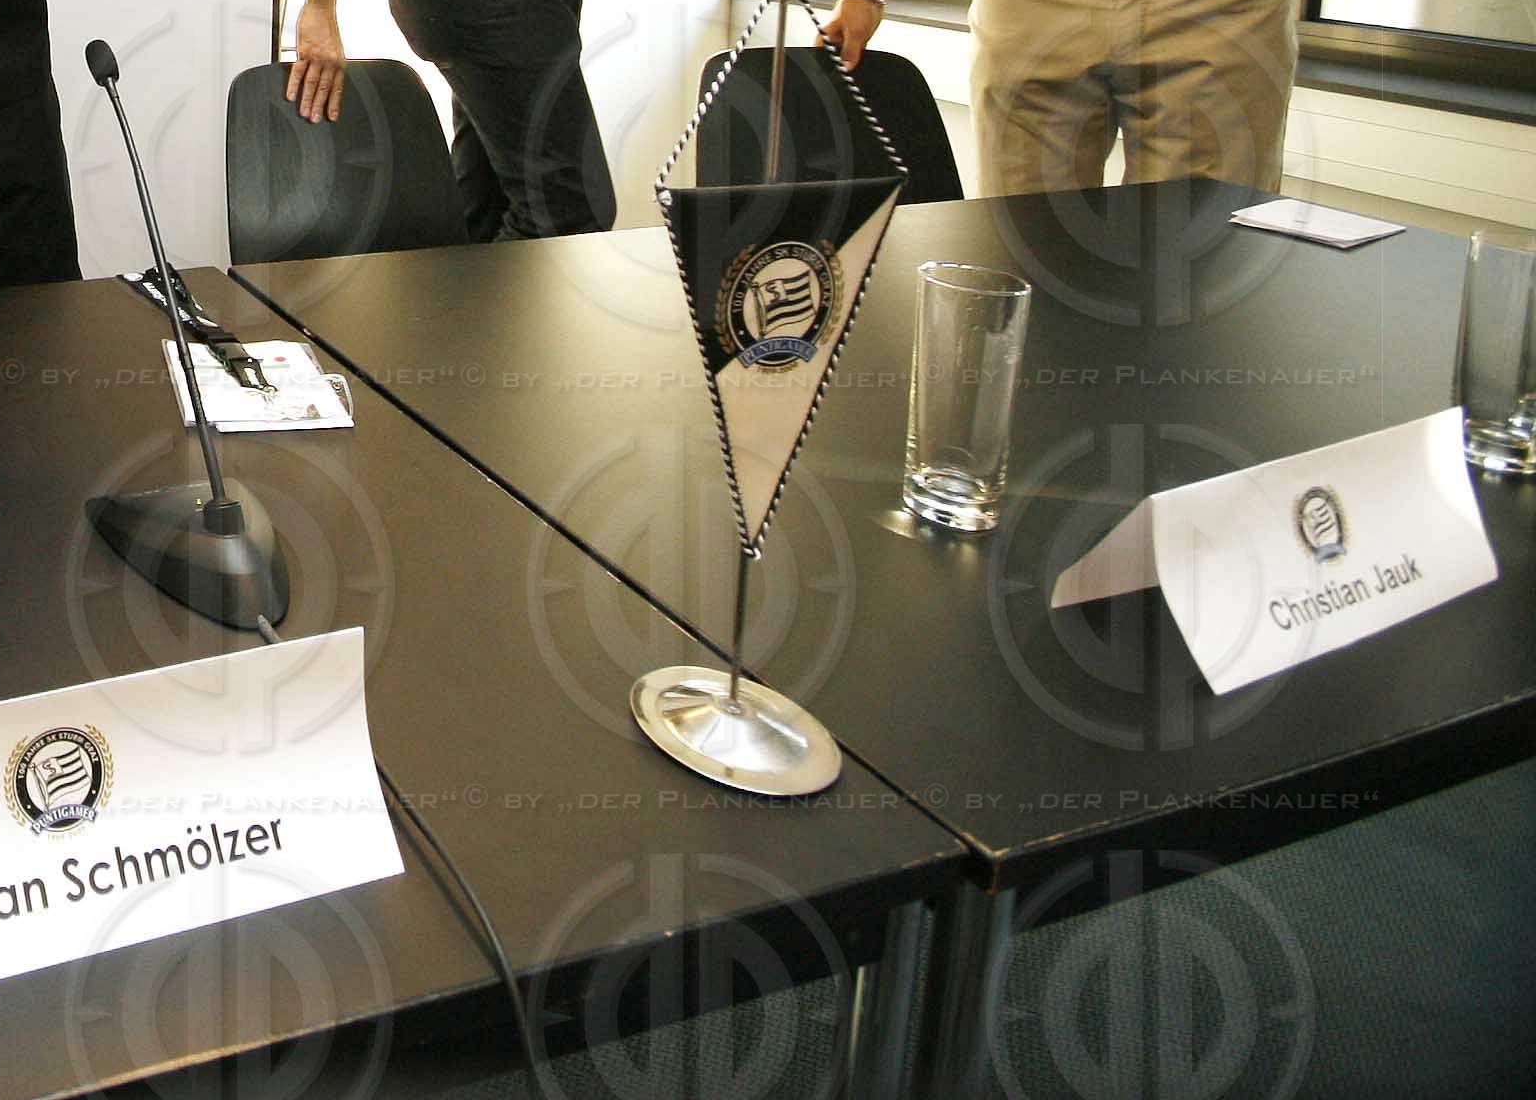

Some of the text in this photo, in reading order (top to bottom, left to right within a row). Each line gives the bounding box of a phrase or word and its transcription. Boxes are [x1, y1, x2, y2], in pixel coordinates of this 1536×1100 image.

[1268, 574, 1371, 632] Christian
[1373, 553, 1424, 595] Jauk
[31, 803, 96, 834] PUNTIGAMER
[63, 815, 284, 904] Schmölzer
